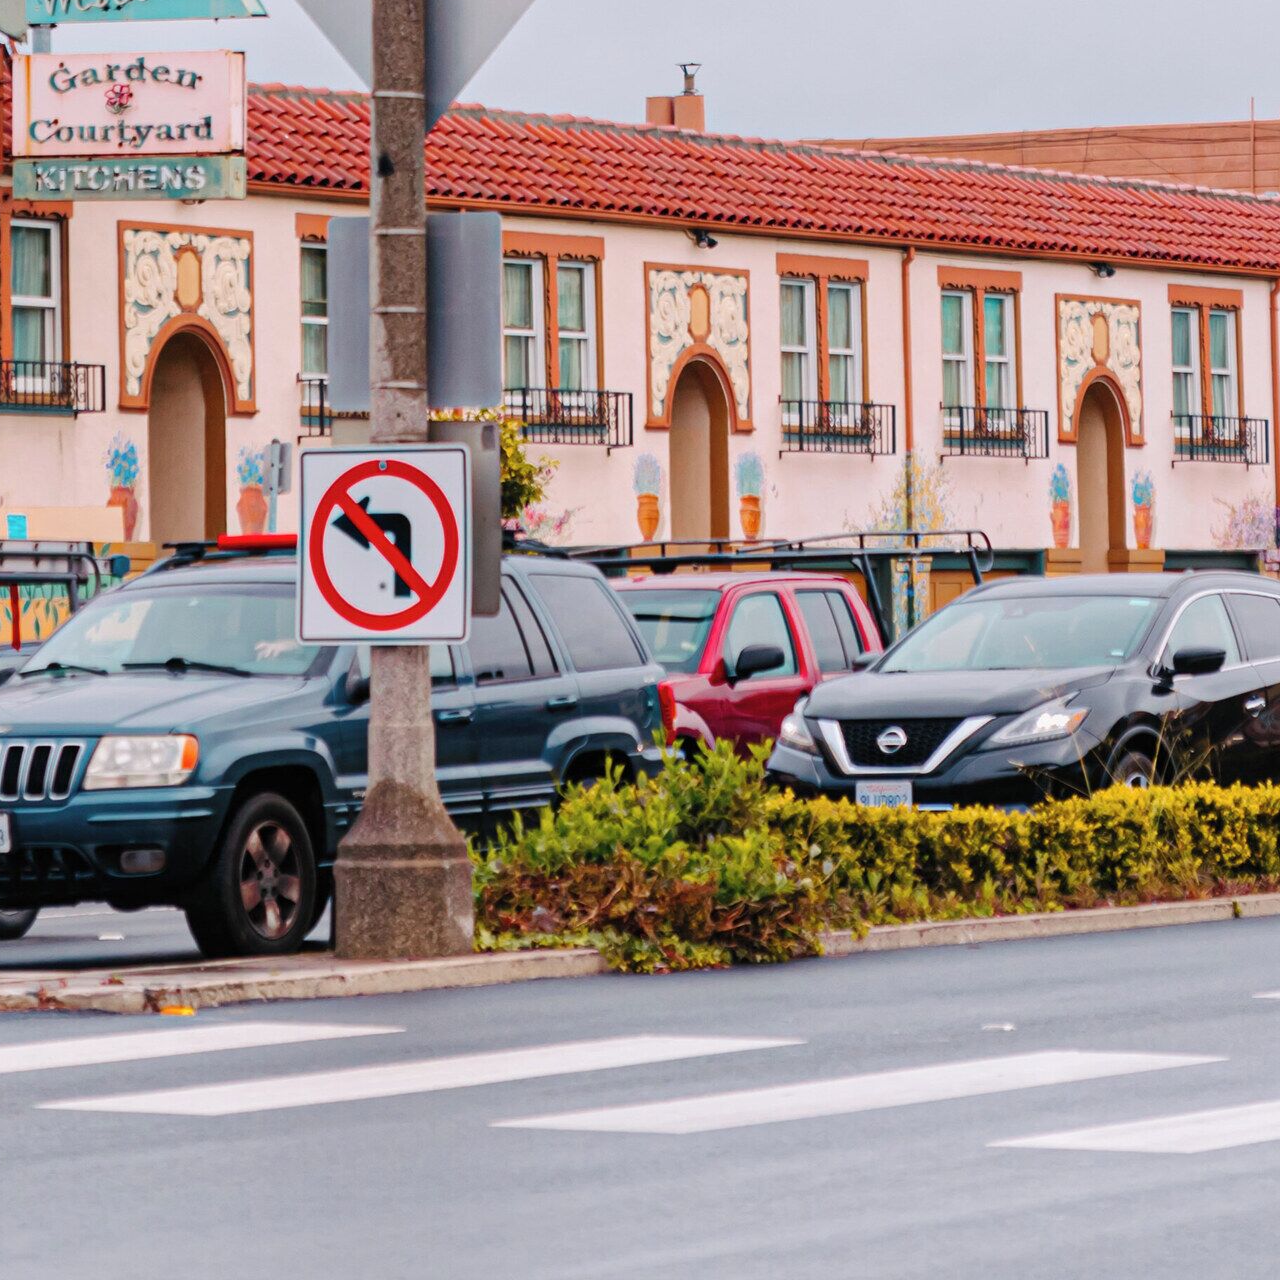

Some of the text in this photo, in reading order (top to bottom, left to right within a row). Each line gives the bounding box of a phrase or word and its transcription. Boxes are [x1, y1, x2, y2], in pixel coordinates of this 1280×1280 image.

[48, 57, 203, 94] Garden
[29, 116, 214, 148] Courtyard
[34, 163, 207, 193] KITCHENS
